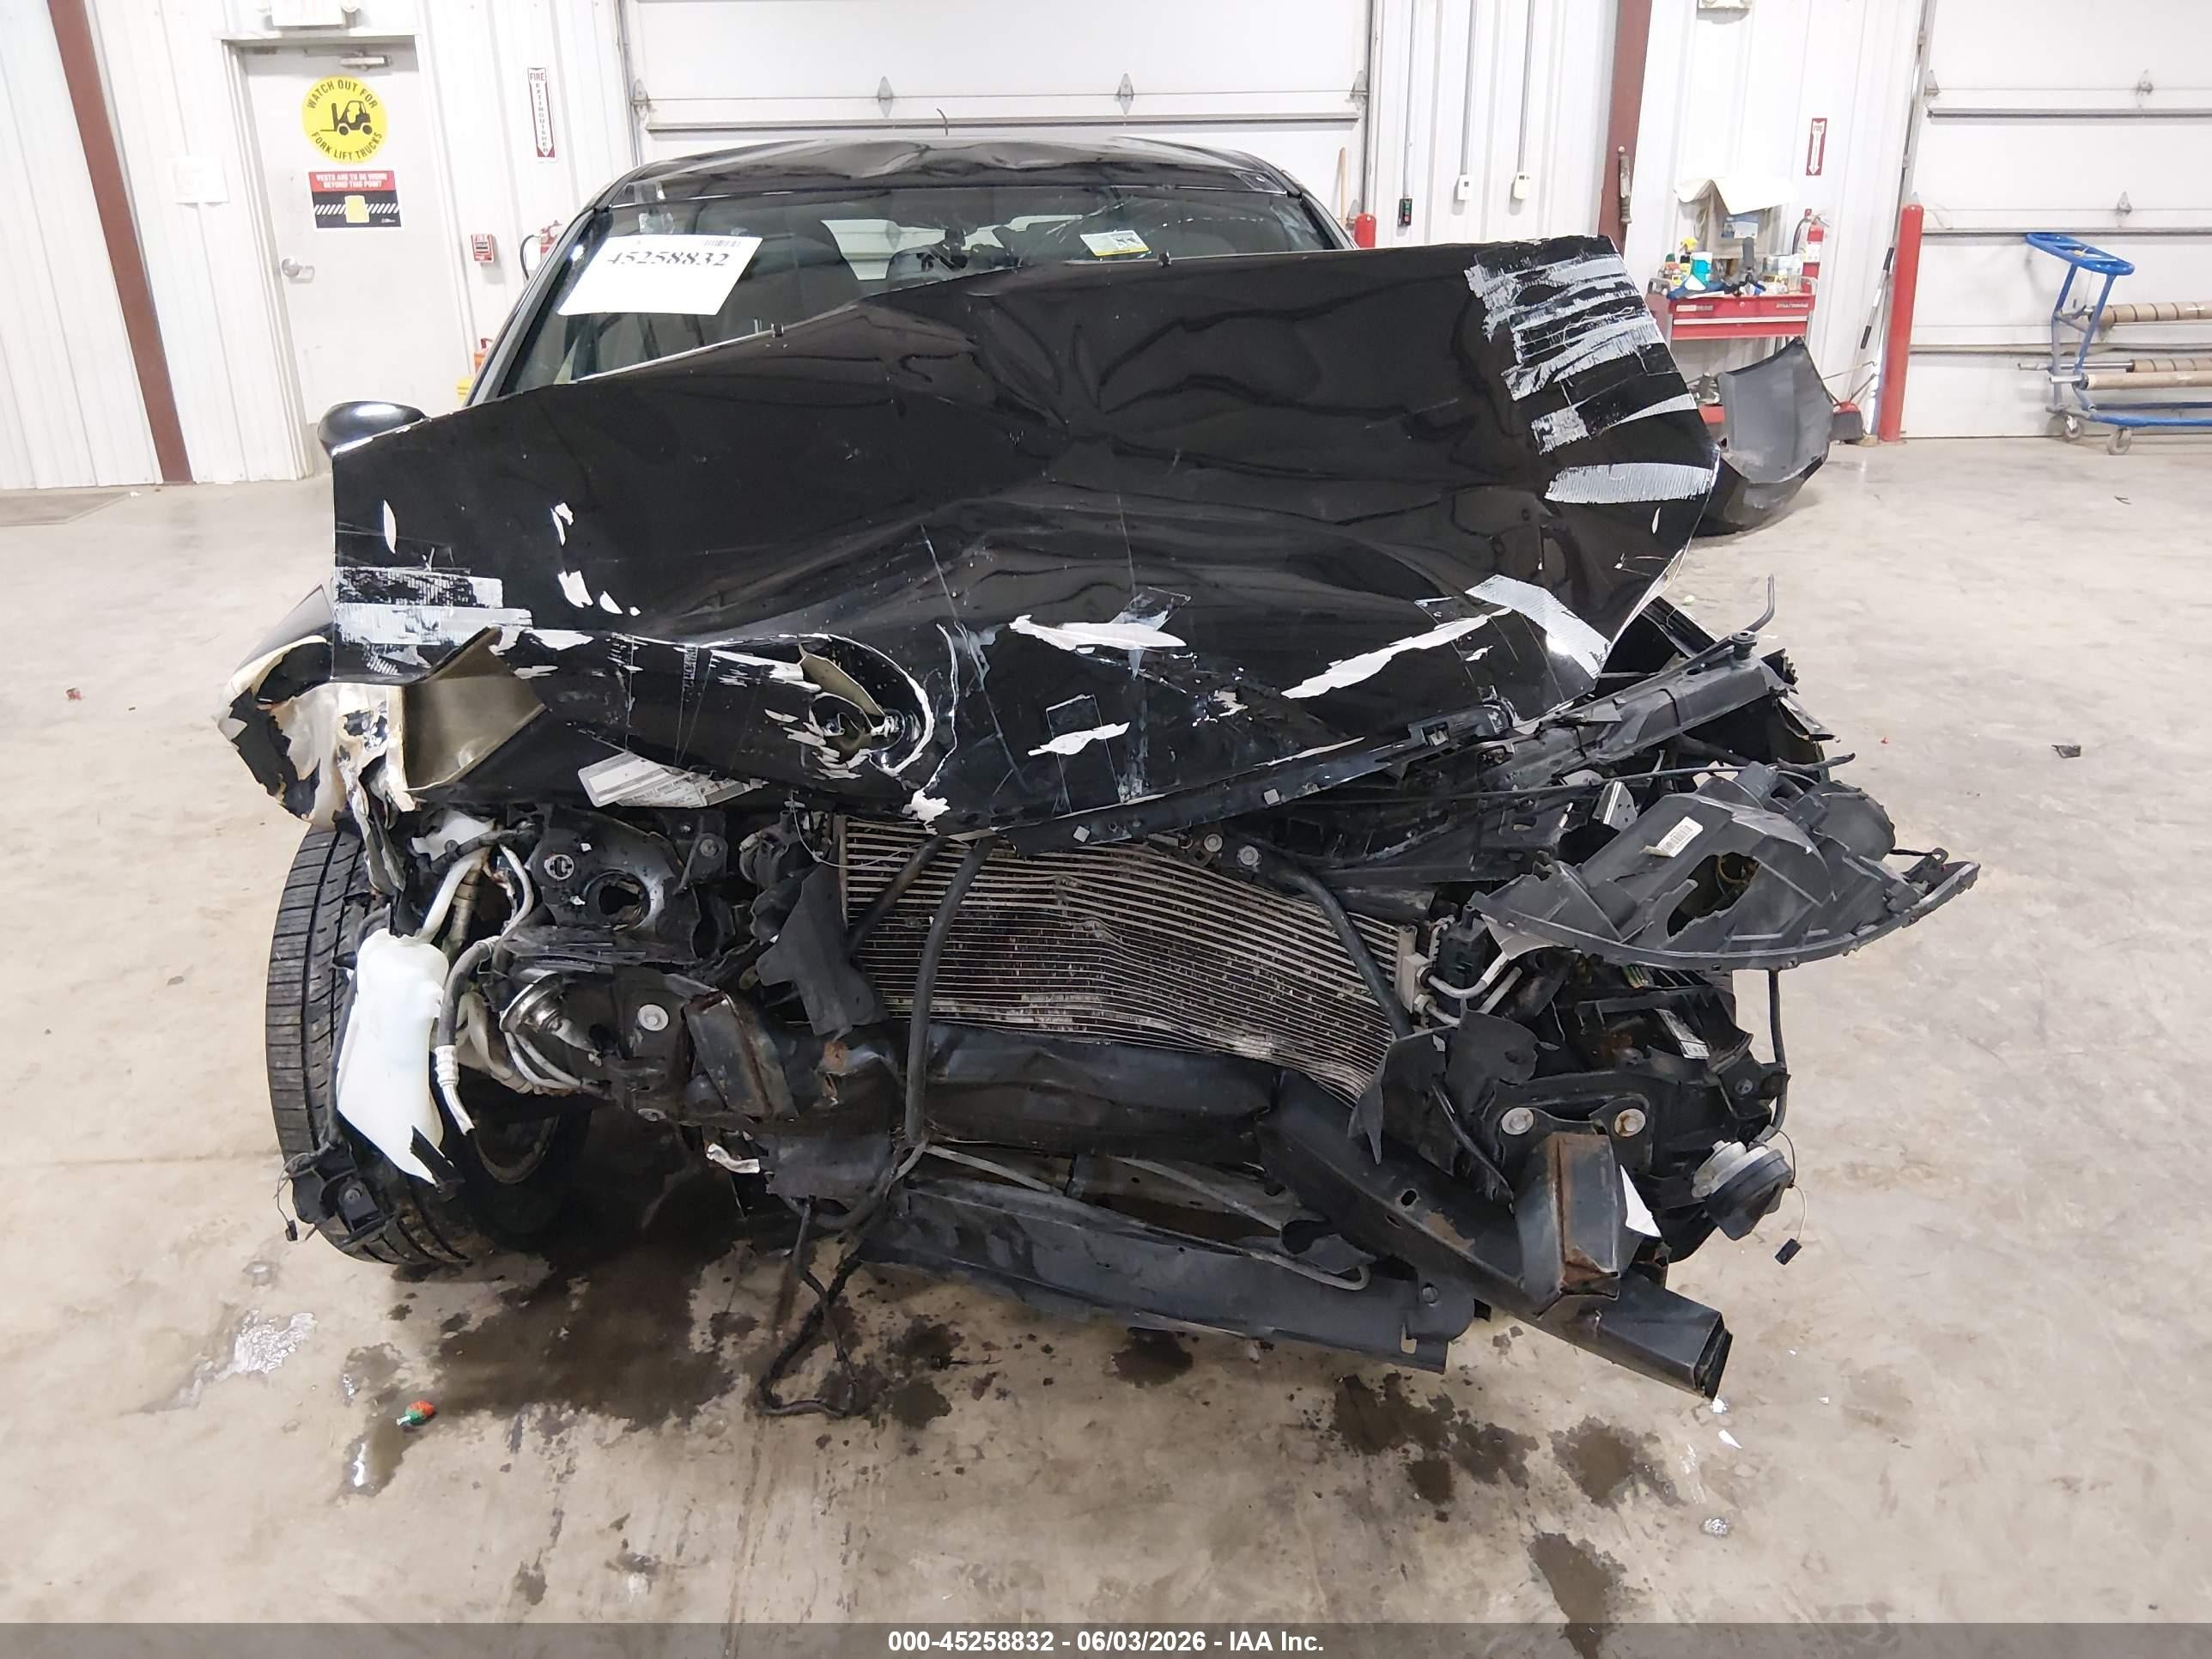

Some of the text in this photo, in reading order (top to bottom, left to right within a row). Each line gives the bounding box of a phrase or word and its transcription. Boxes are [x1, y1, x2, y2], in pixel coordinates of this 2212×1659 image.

[307, 79, 378, 109] WATCH OUT FOR
[311, 131, 383, 161] FORK LIFT TRUCKS
[606, 251, 730, 266] 45258832
